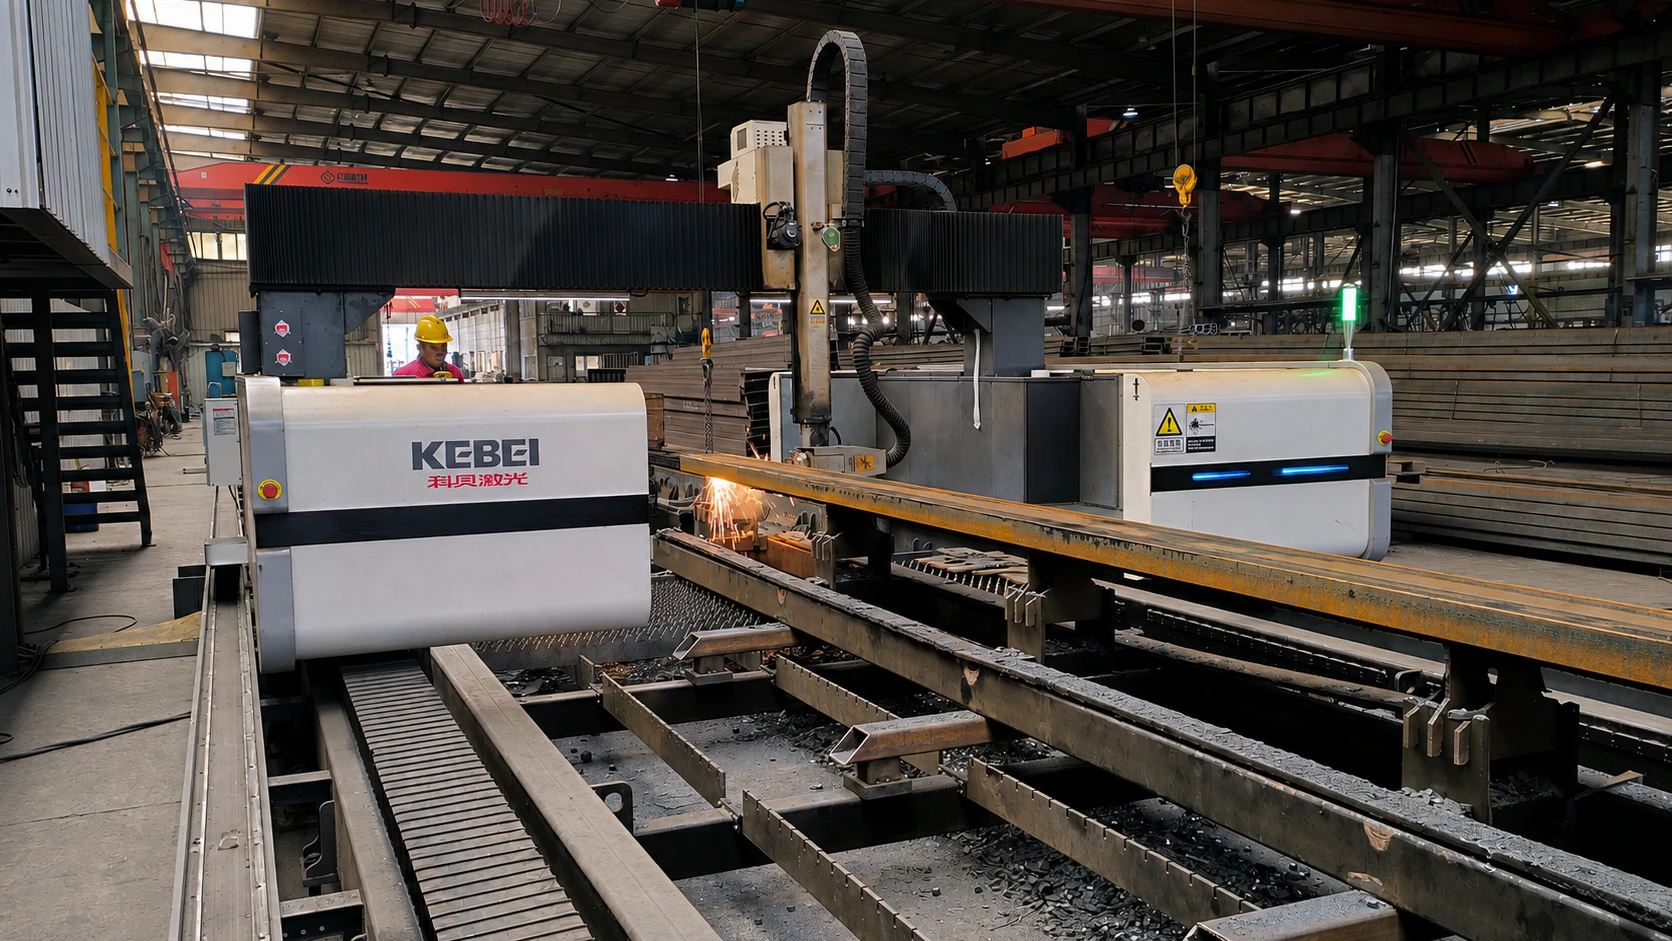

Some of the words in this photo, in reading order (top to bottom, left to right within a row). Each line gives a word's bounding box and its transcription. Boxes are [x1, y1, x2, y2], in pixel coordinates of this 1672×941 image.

[412, 438, 540, 470] KEBEI
[427, 472, 528, 488] 科贝激光
